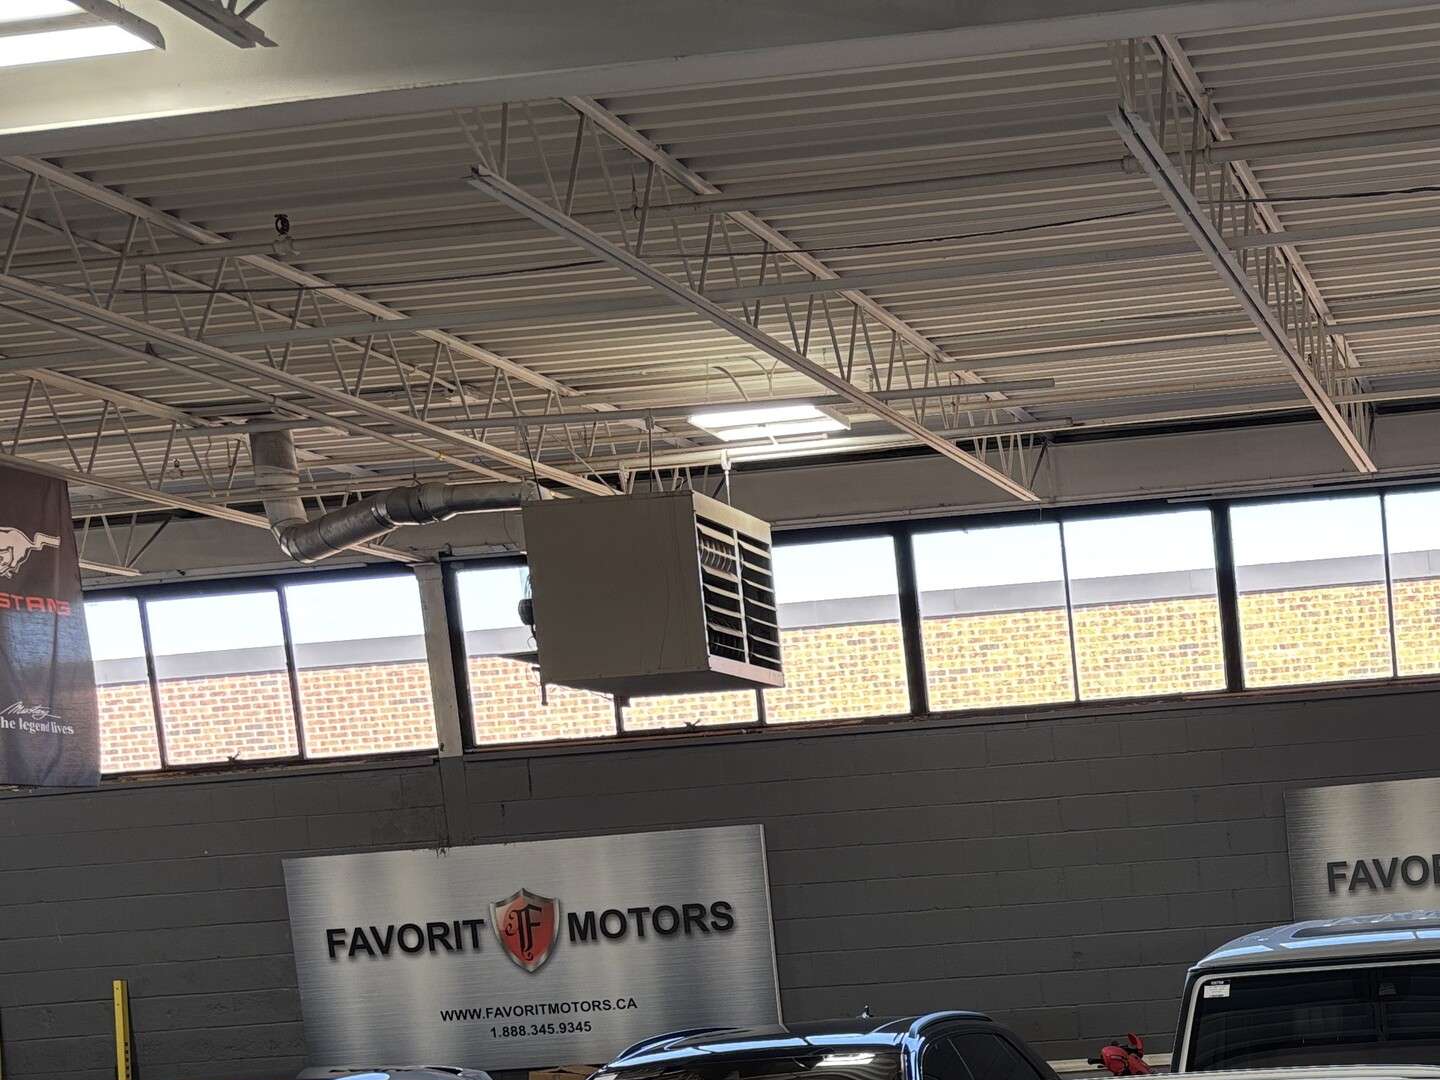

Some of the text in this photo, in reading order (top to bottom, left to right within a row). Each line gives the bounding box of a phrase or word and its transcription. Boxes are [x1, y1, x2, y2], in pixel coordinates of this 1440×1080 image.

[51, 721, 74, 735] lives
[326, 918, 485, 958] FAVORIT
[567, 901, 734, 943] MOTORS
[440, 997, 638, 1022] WWW.FAVORITMOTORS.CA
[490, 1021, 592, 1038] 1.888.345.9345
